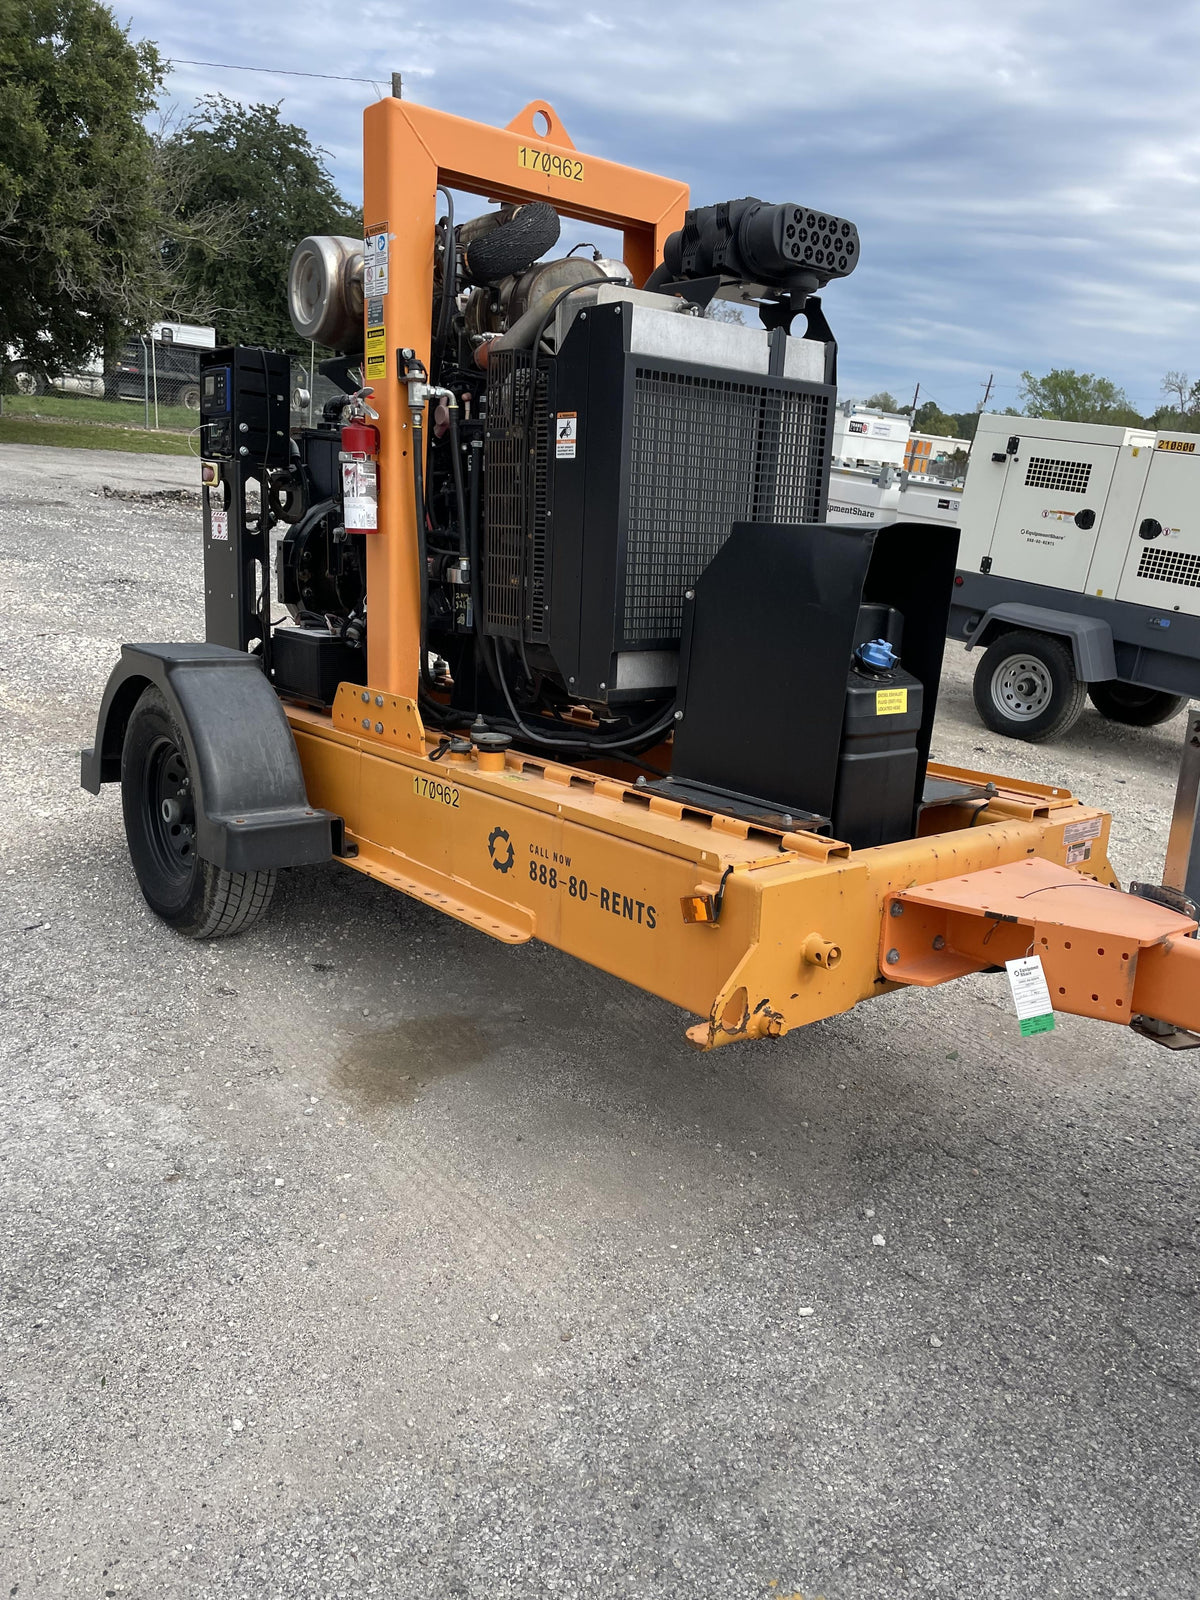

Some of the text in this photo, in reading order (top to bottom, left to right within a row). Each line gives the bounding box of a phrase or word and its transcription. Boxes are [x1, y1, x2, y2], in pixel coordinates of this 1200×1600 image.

[520, 147, 583, 181] 170962
[1158, 440, 1196, 452] 210800
[414, 776, 460, 808] 170962
[529, 843, 572, 867] CALL NOW
[529, 860, 657, 929] 888-80-RENTS
